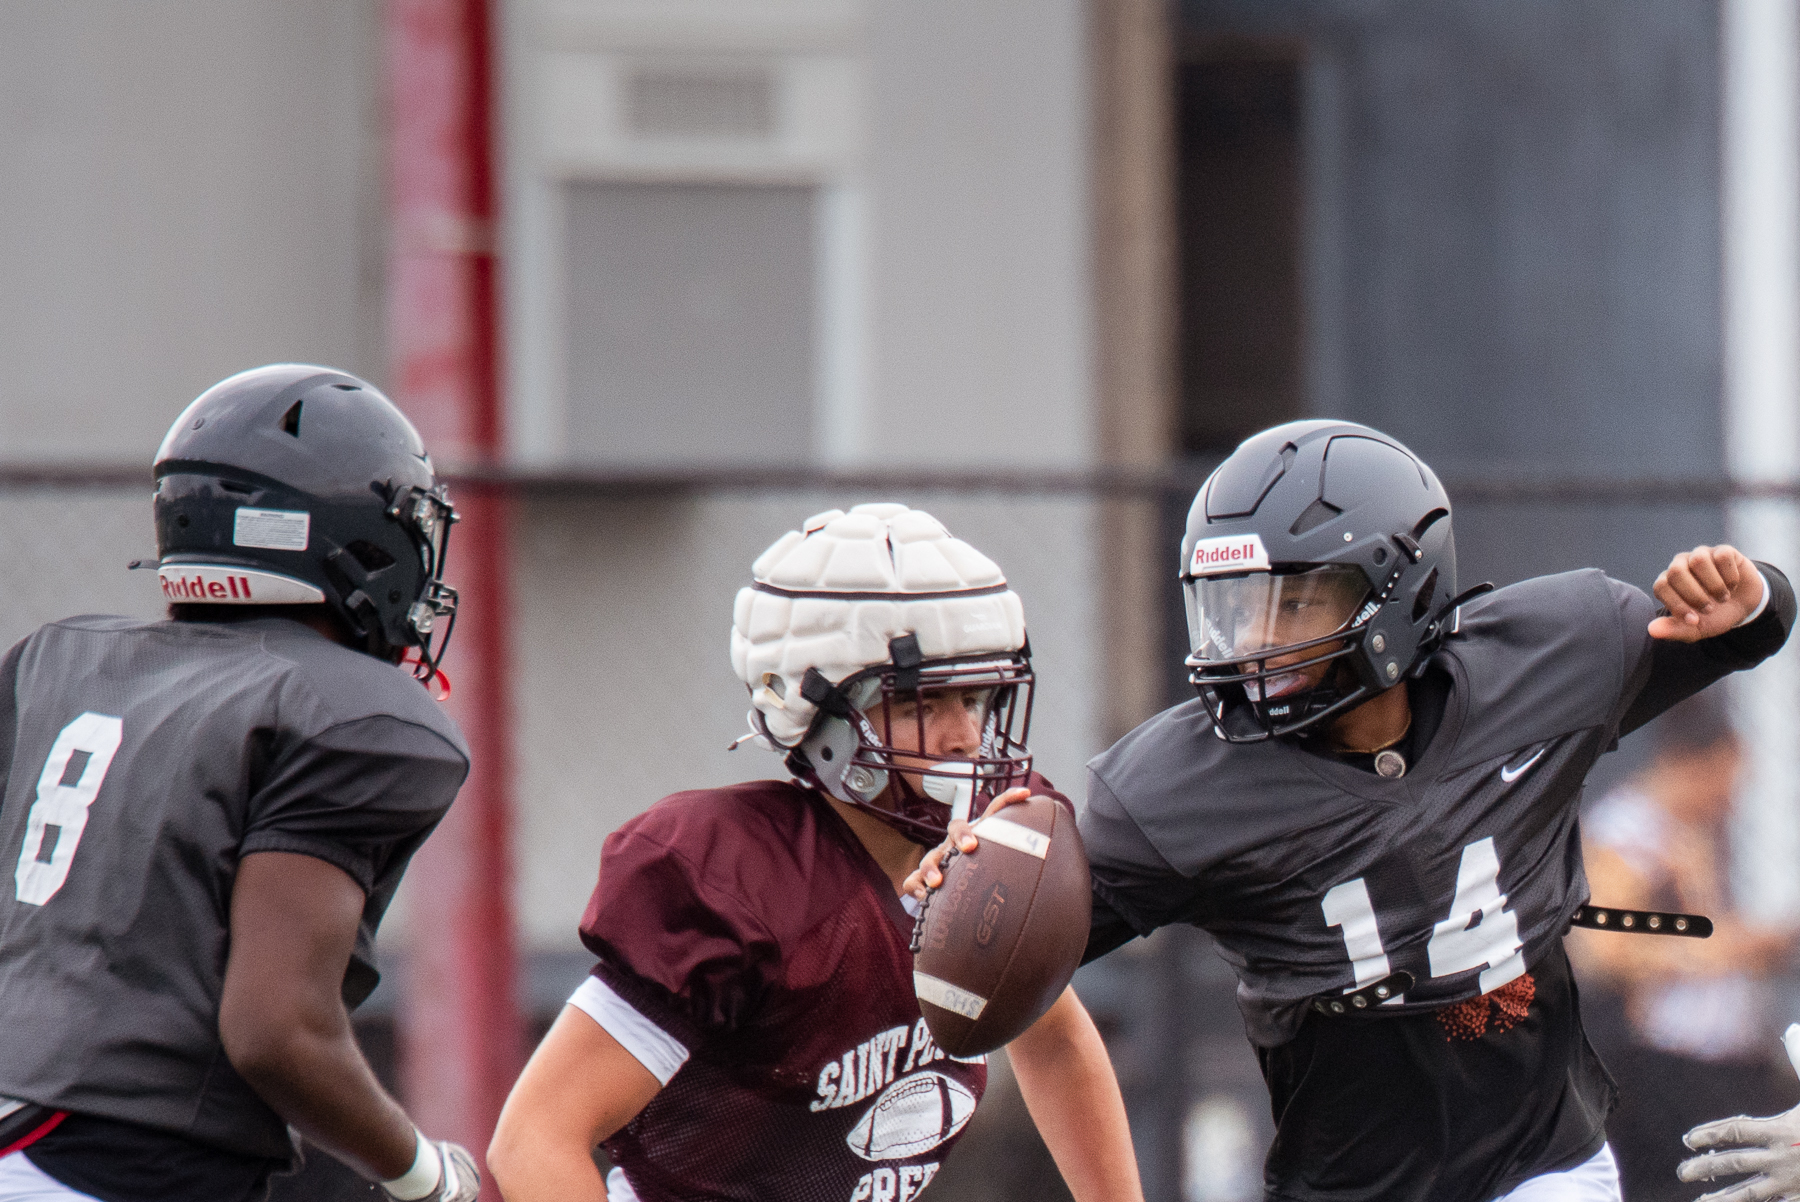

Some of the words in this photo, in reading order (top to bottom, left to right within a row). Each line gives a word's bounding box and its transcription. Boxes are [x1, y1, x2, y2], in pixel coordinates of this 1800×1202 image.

[1195, 543, 1255, 565] Riddell
[159, 574, 252, 599] Riddell
[1351, 601, 1379, 628] dell
[14, 711, 123, 907] 8
[976, 884, 1006, 946] GST
[1320, 836, 1527, 1006] 14
[809, 1025, 909, 1113] SAINT
